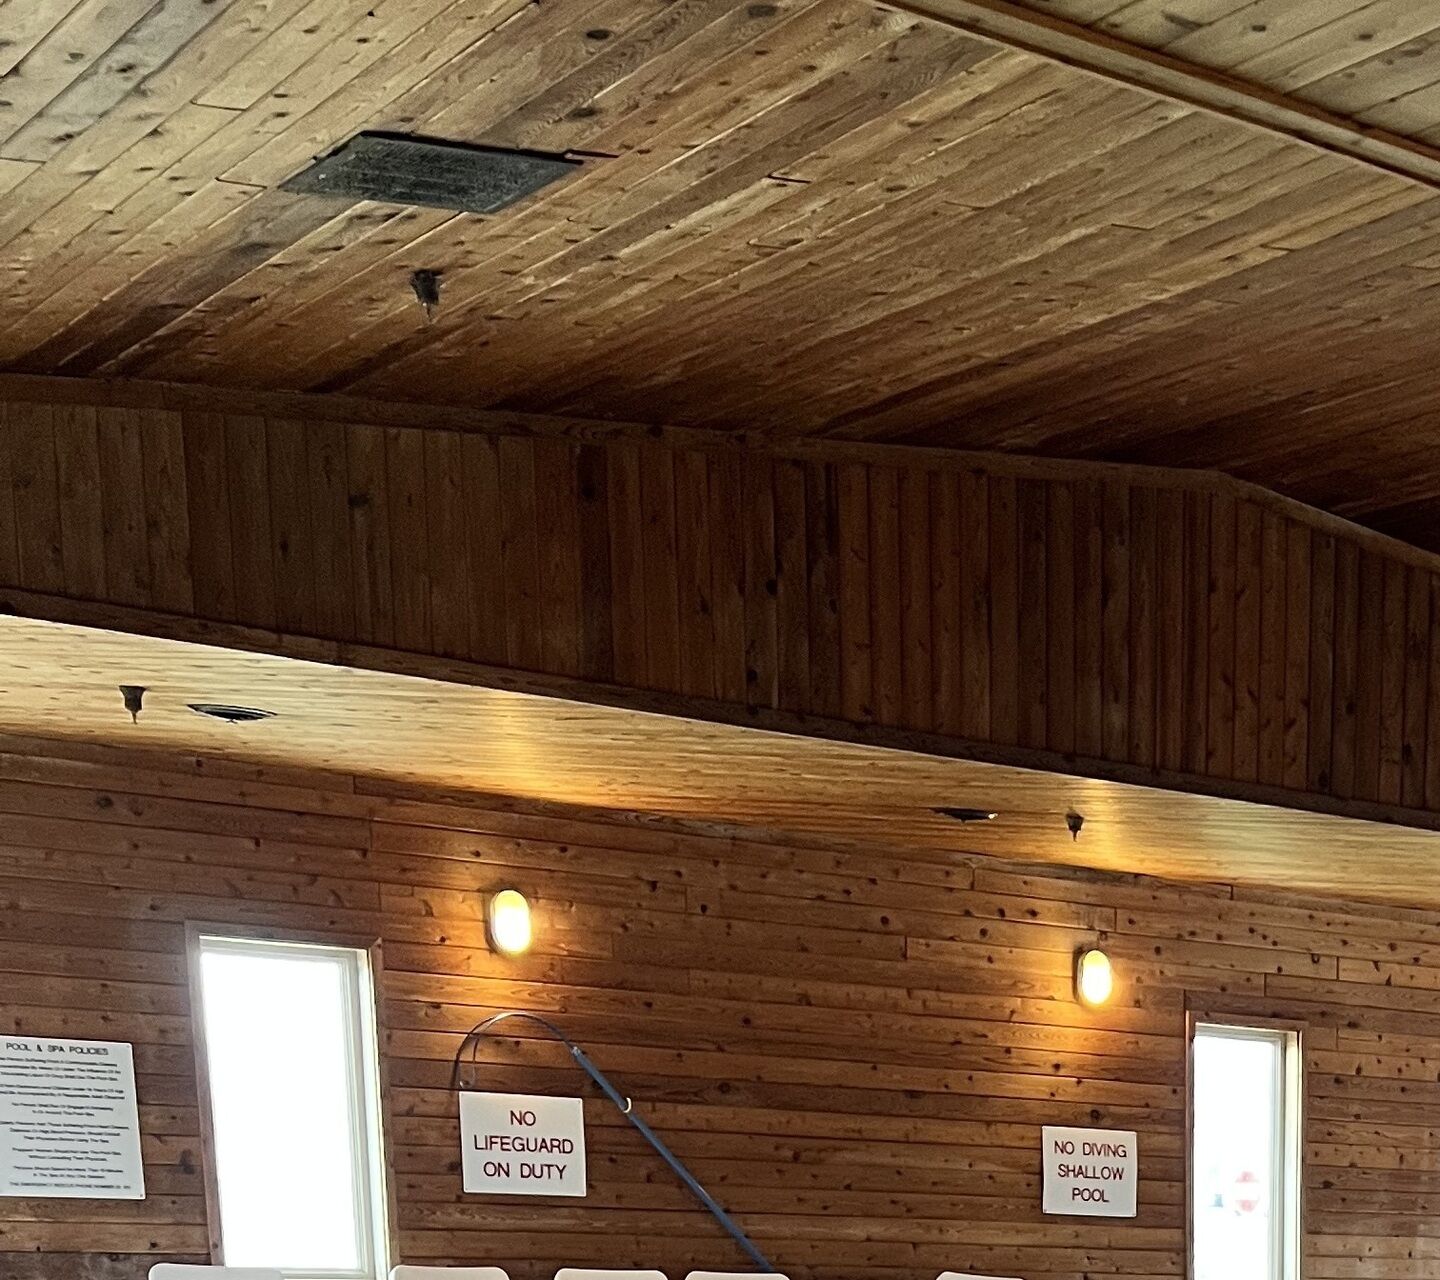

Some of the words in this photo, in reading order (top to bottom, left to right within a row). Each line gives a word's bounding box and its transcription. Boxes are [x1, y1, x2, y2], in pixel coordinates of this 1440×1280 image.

[6, 1042, 32, 1051] POOL
[47, 1044, 65, 1053] SPA
[69, 1046, 109, 1056] POLICIES
[510, 1110, 537, 1127] NO
[474, 1134, 574, 1154] LIFEGUARD
[1054, 1140, 1075, 1155] NO
[1082, 1142, 1127, 1158] DIVING
[483, 1161, 510, 1178] ON
[520, 1162, 567, 1180] DUTY
[1057, 1163, 1125, 1181] SHALLOW
[1072, 1187, 1110, 1203] POOL
